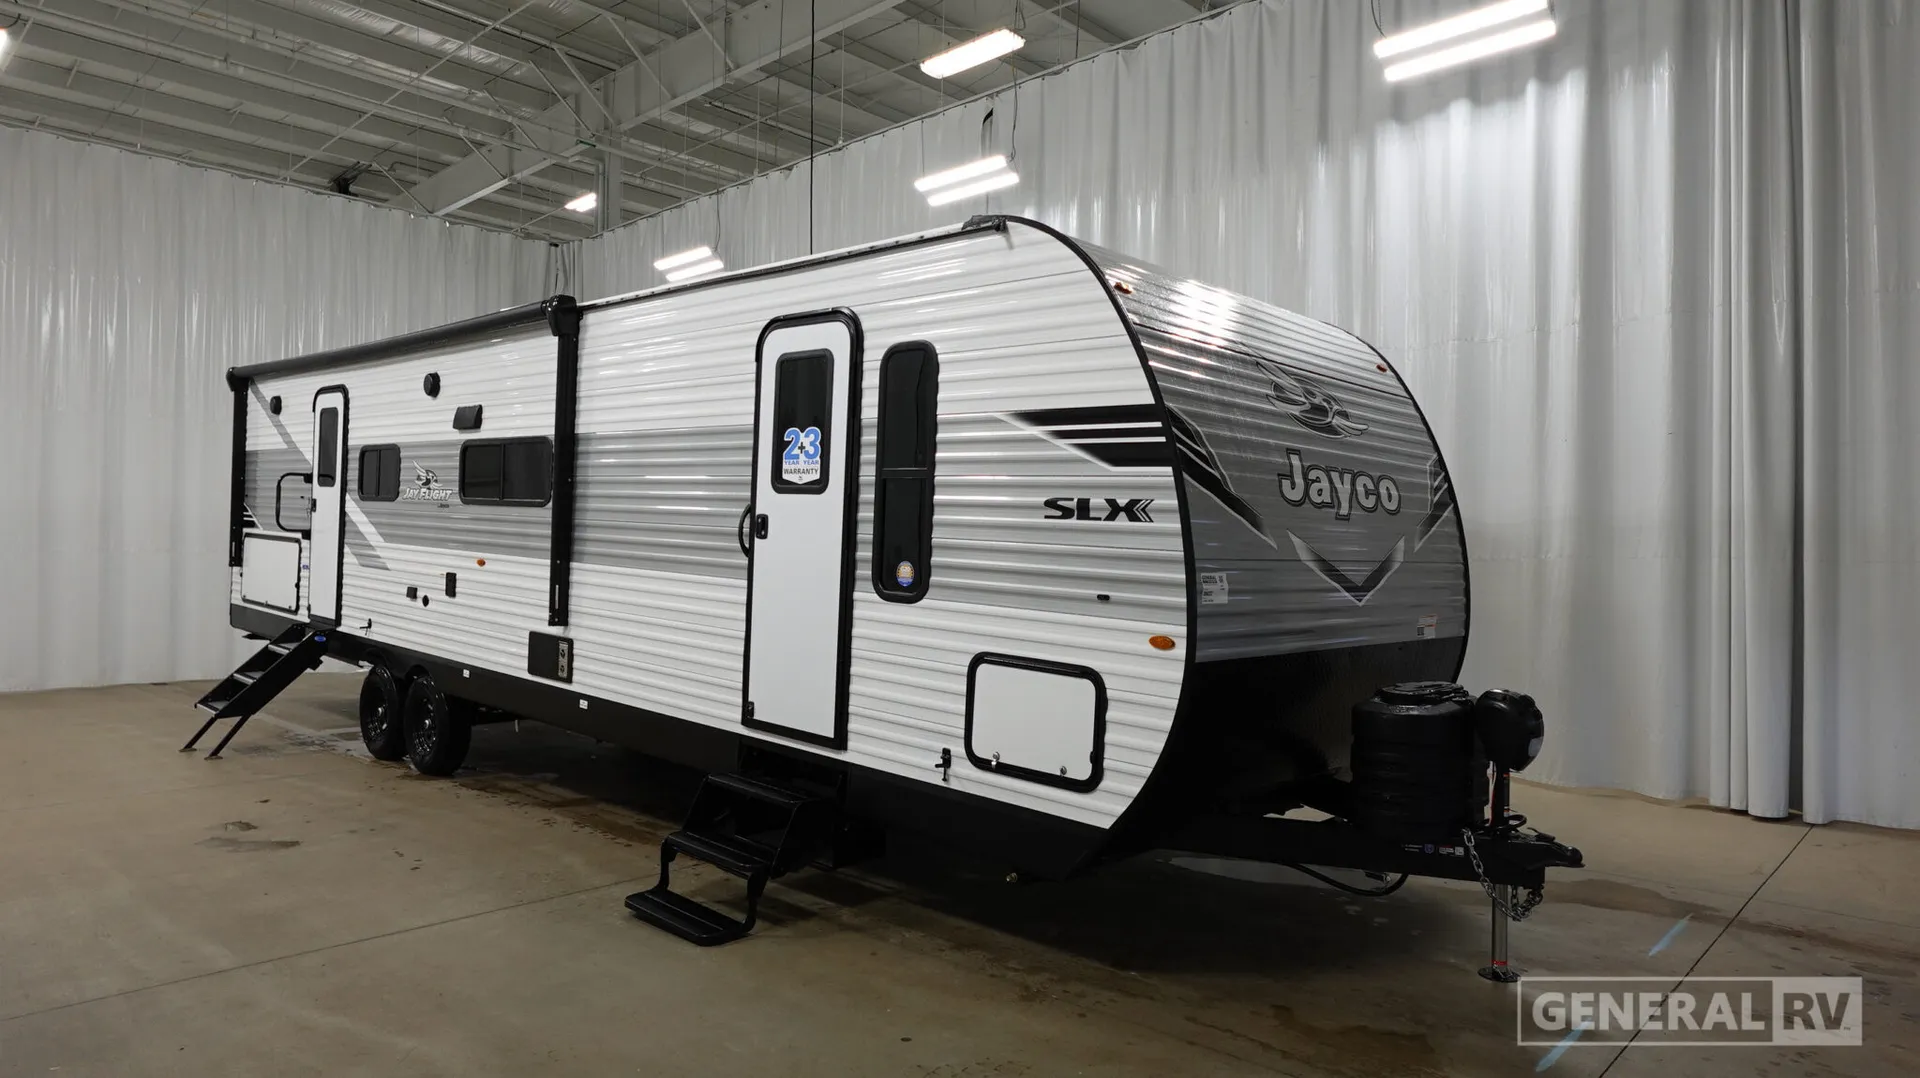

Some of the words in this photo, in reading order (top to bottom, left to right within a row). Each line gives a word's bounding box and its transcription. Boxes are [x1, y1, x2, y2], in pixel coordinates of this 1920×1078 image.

[783, 467, 819, 475] WARRANTY
[402, 487, 419, 501] JAY
[418, 488, 453, 501] FLIGHT
[1277, 448, 1401, 520] Jayco
[1043, 497, 1154, 523] SLX
